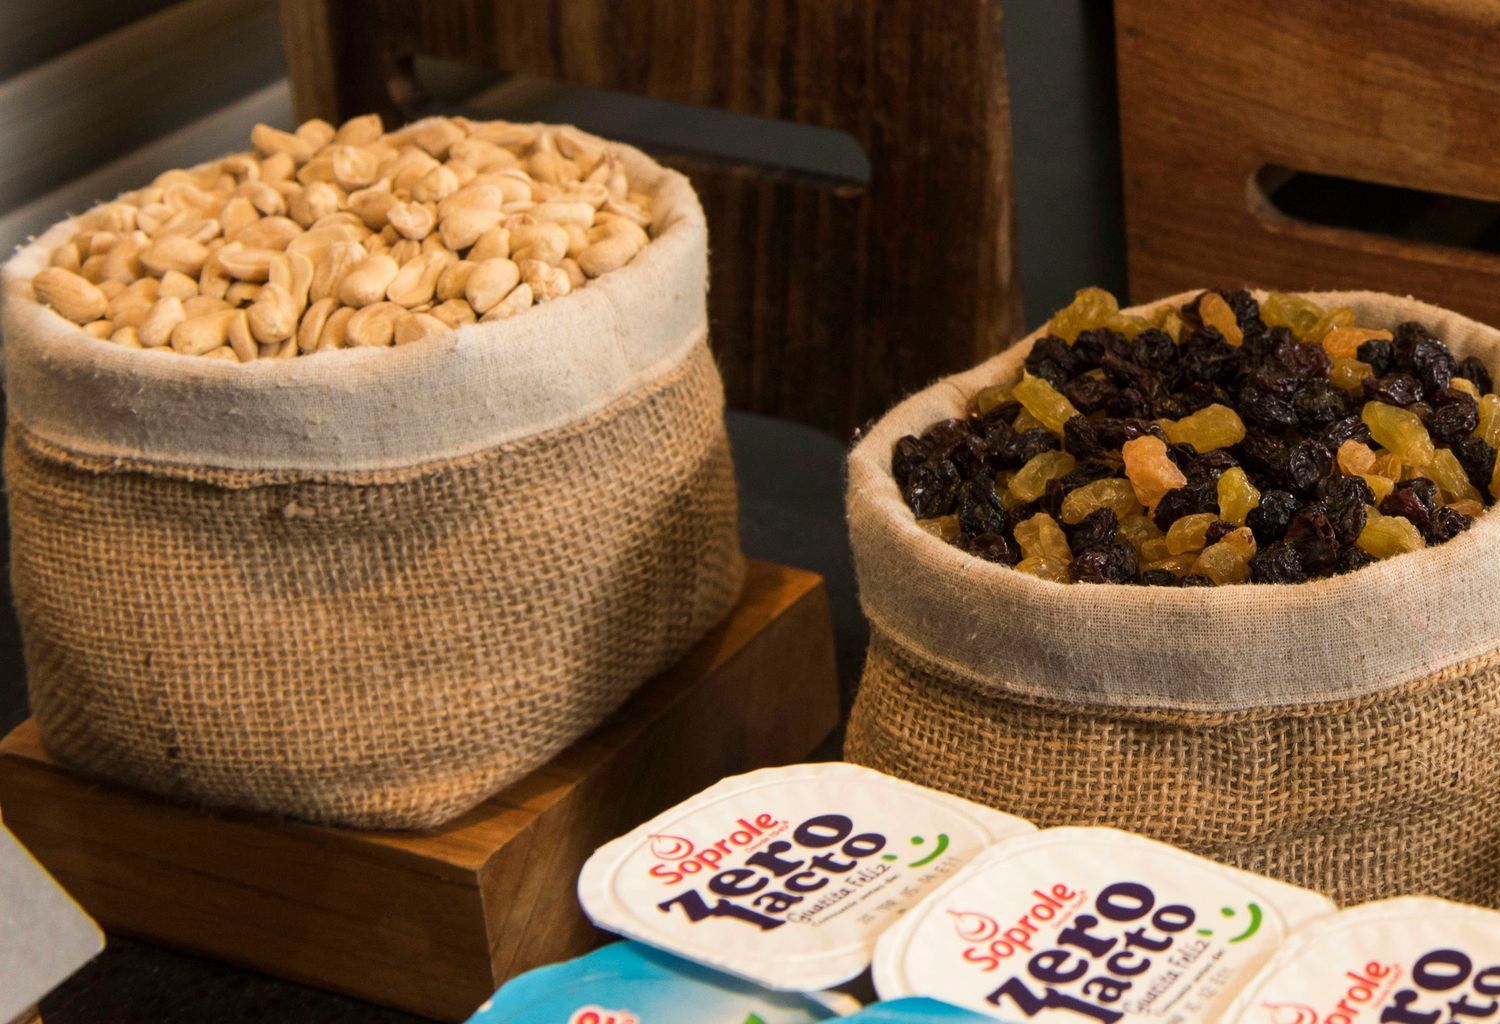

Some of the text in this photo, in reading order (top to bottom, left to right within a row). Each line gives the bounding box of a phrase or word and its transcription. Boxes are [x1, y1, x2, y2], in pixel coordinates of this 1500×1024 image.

[649, 813, 779, 885] Soprole
[657, 814, 854, 922] zero
[717, 833, 887, 931] lacto
[962, 883, 1077, 972] Soprole
[985, 882, 1156, 1017] zero
[1045, 904, 1196, 1024] lacto
[1324, 961, 1390, 1024] role
[1380, 949, 1472, 1024] ro
